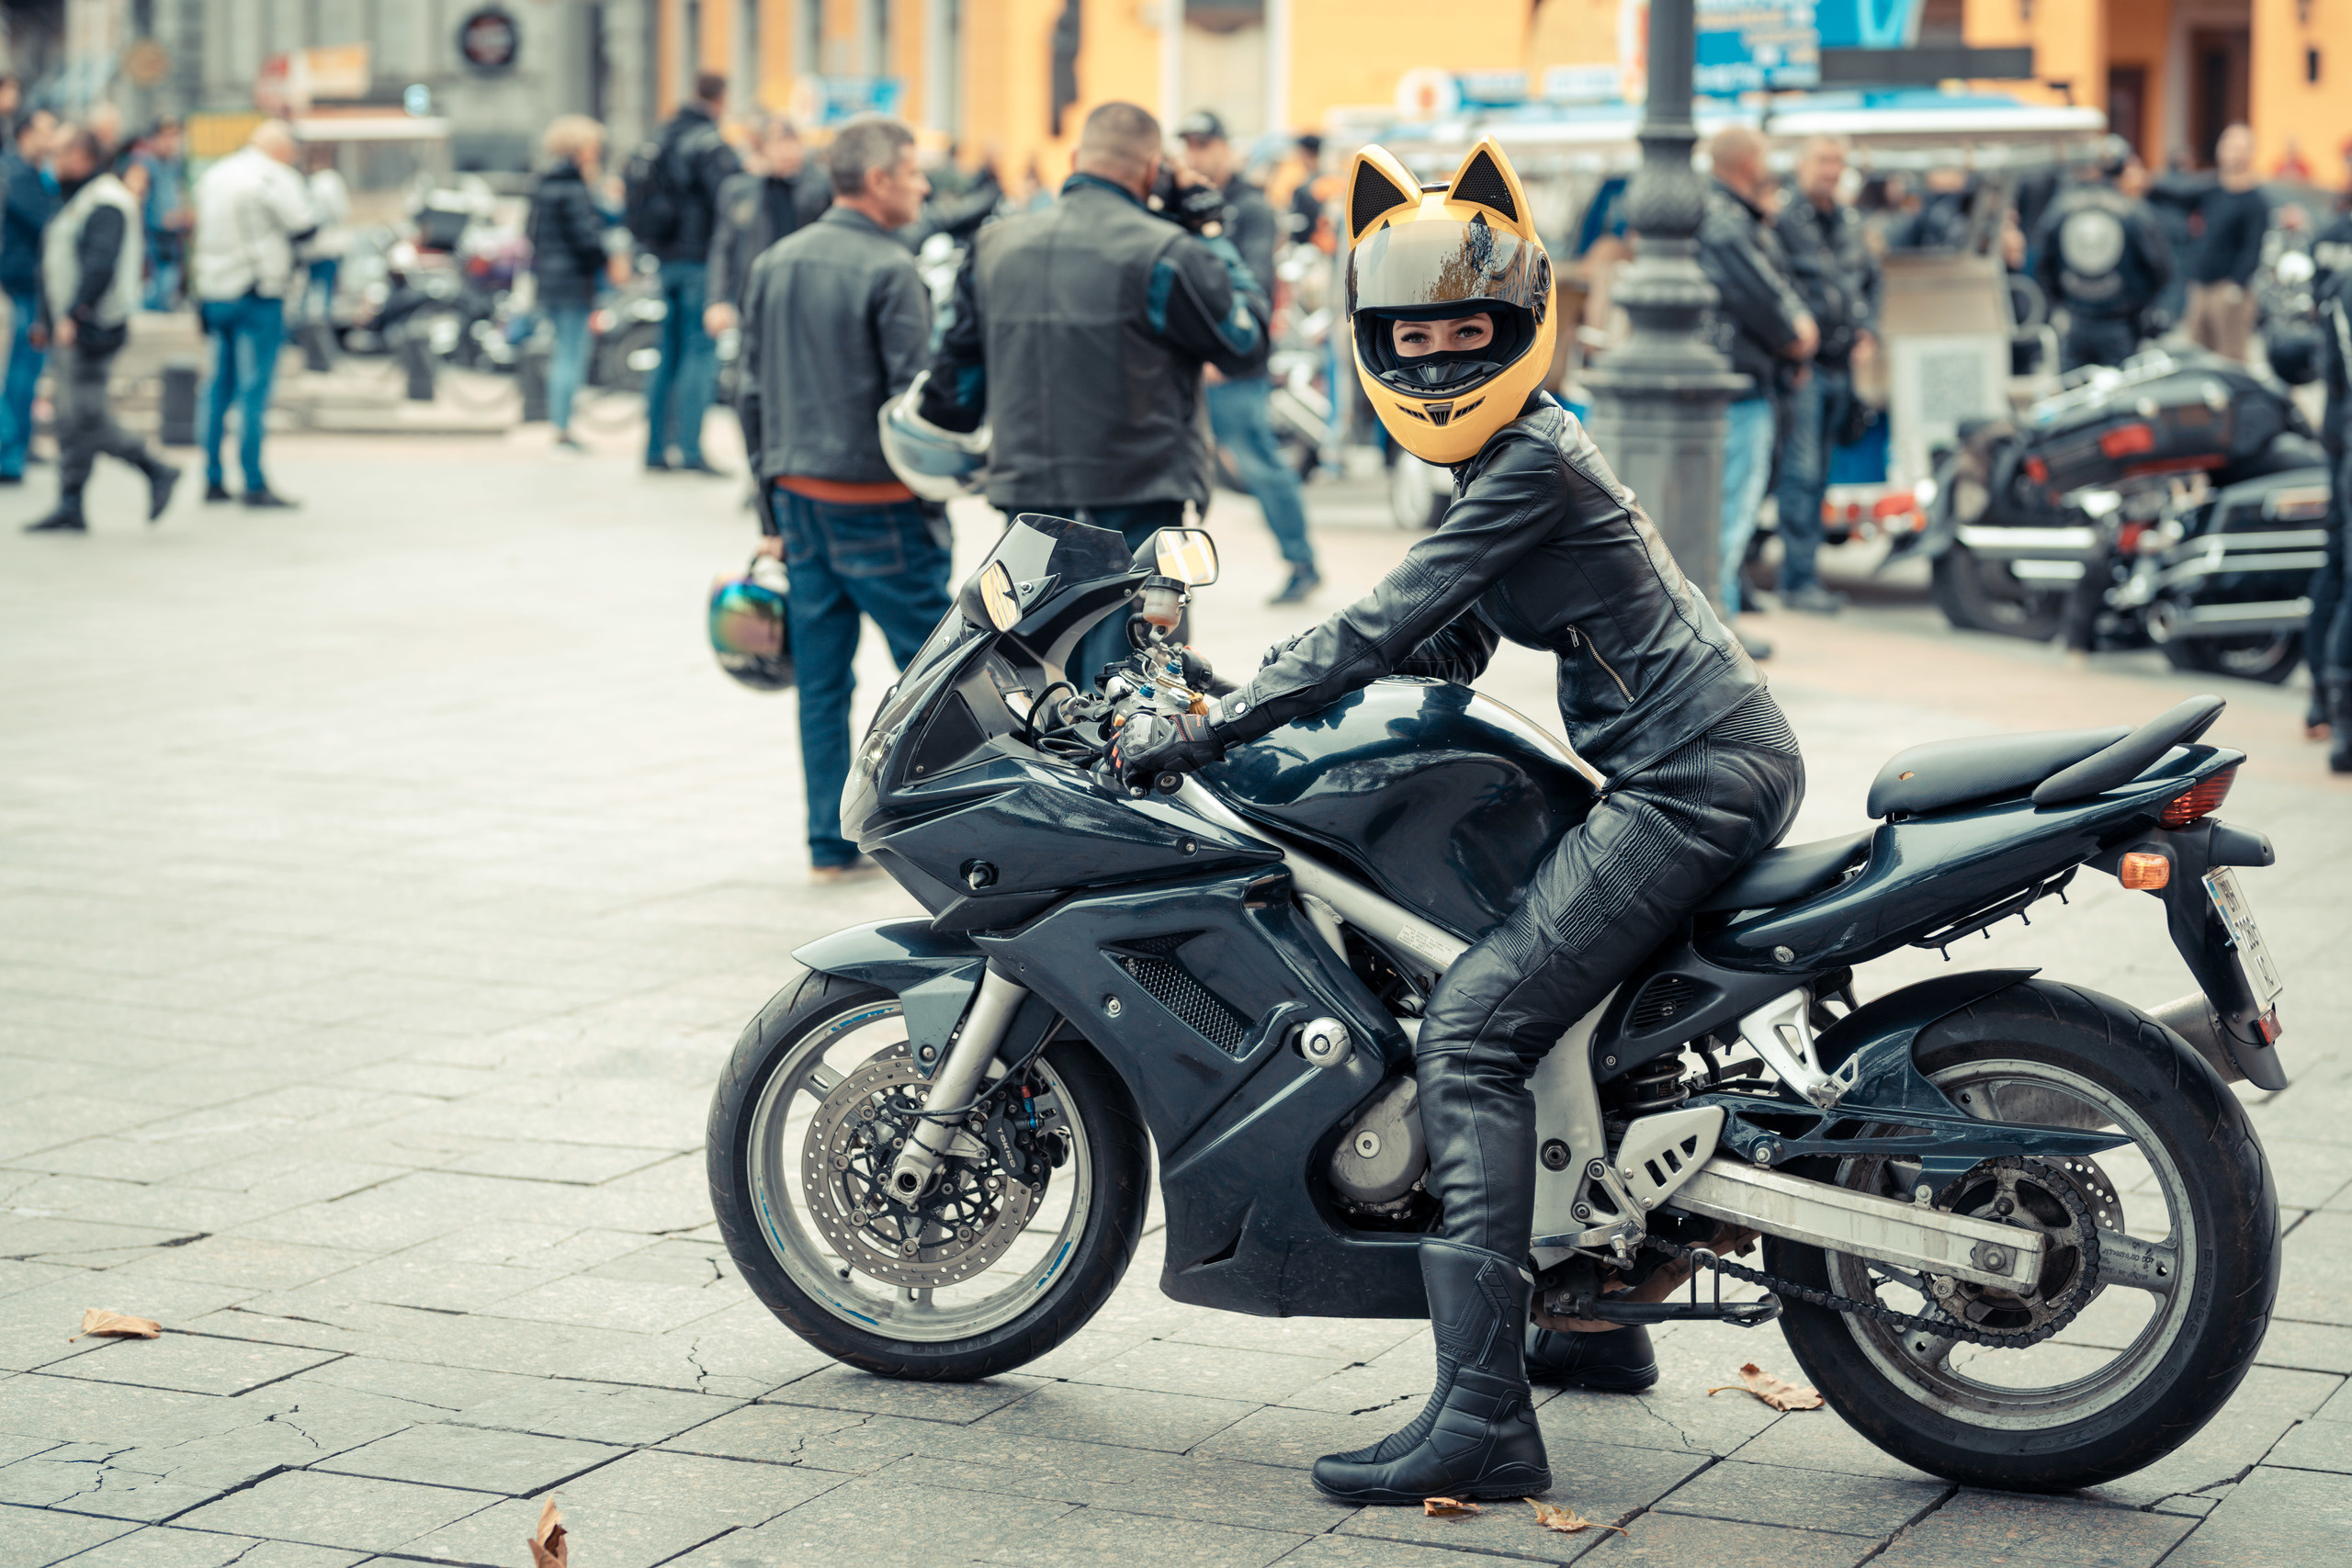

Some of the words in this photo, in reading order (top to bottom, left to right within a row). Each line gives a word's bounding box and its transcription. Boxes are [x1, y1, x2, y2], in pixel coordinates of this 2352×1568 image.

[2219, 878, 2241, 912] BH
[2255, 955, 2275, 989] AC
[997, 1126, 1016, 1168] TOKICO
